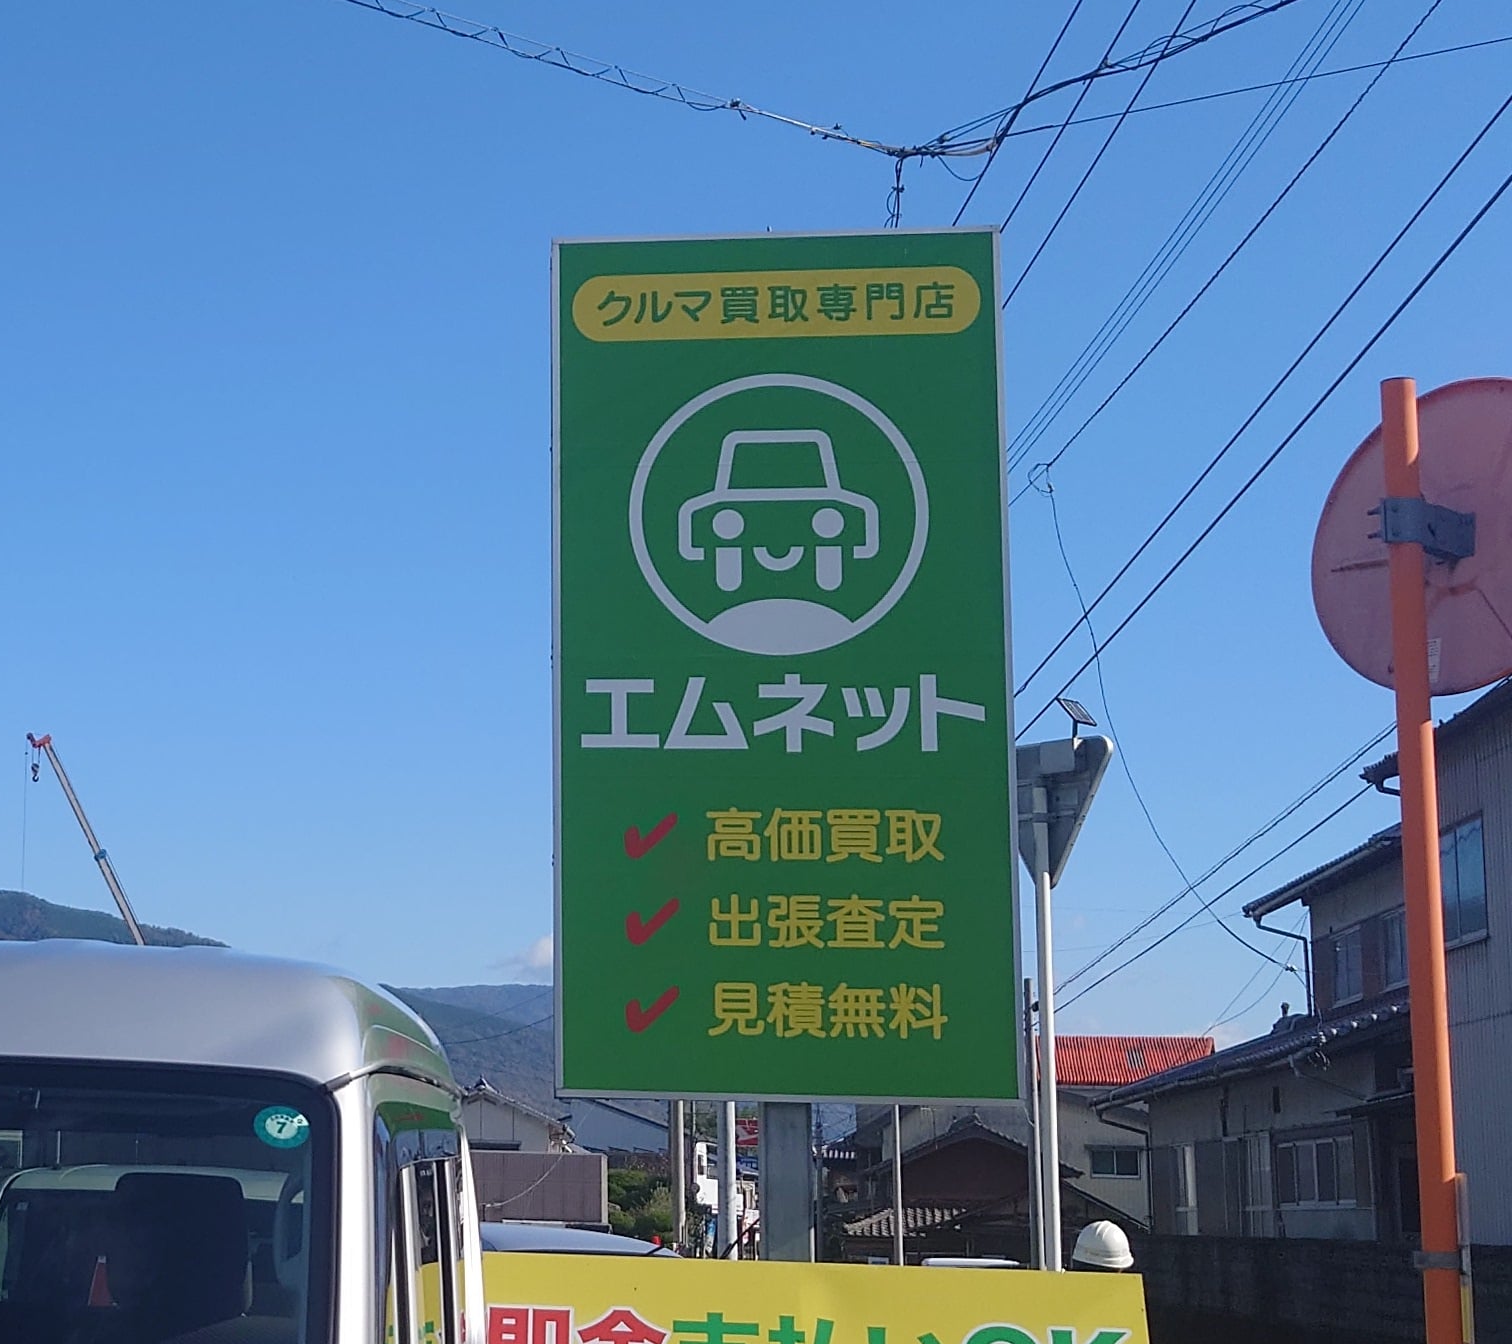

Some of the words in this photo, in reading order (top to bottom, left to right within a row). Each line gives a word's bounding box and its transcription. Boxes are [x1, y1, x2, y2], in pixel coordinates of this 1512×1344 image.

[595, 280, 956, 327] クルマ買取専門店
[580, 672, 987, 754] エムネット
[705, 807, 946, 865] 高価買取
[707, 894, 947, 951] 出張査定
[707, 981, 949, 1041] 見積無料
